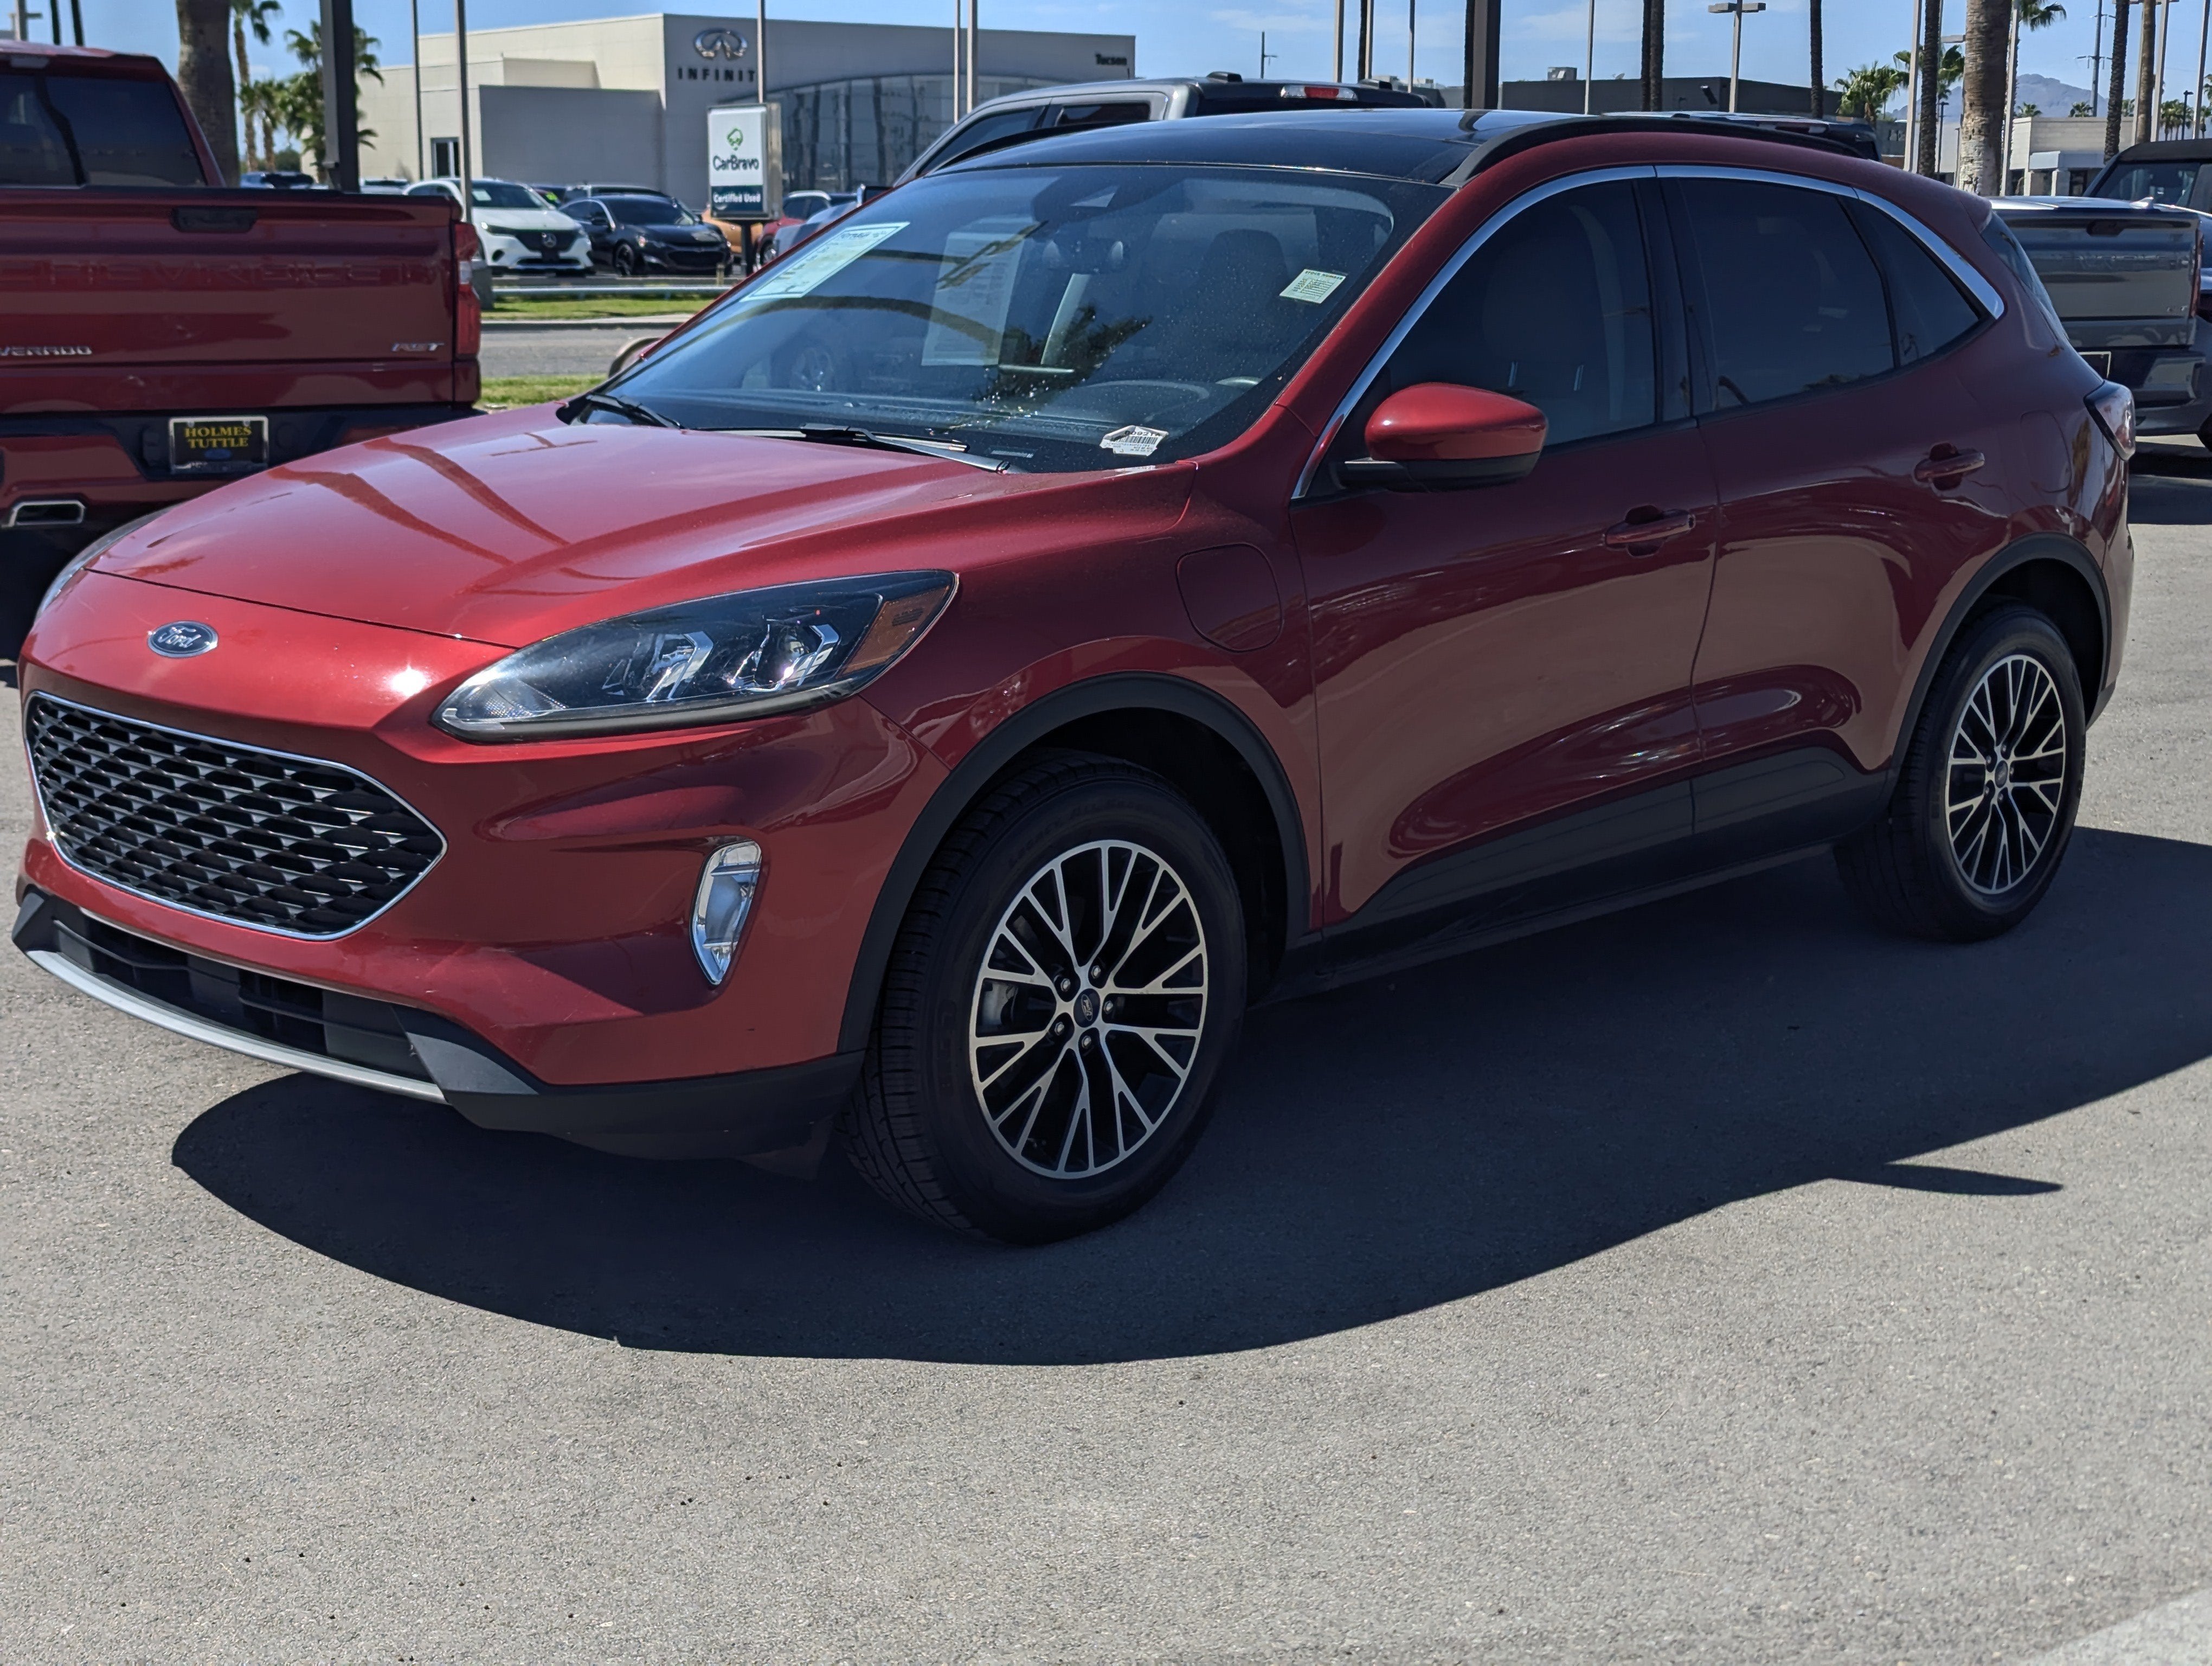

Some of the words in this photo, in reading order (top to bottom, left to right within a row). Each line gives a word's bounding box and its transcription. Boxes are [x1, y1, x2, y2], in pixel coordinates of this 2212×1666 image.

[1096, 53, 1127, 65] Tucson
[678, 68, 755, 81] INFINIT
[713, 155, 759, 171] CarBravo
[713, 193, 742, 203] Certified
[744, 193, 761, 203] Used
[185, 427, 252, 437] HOLMES
[189, 438, 248, 447] TUTTLE
[157, 625, 202, 648] Ford
